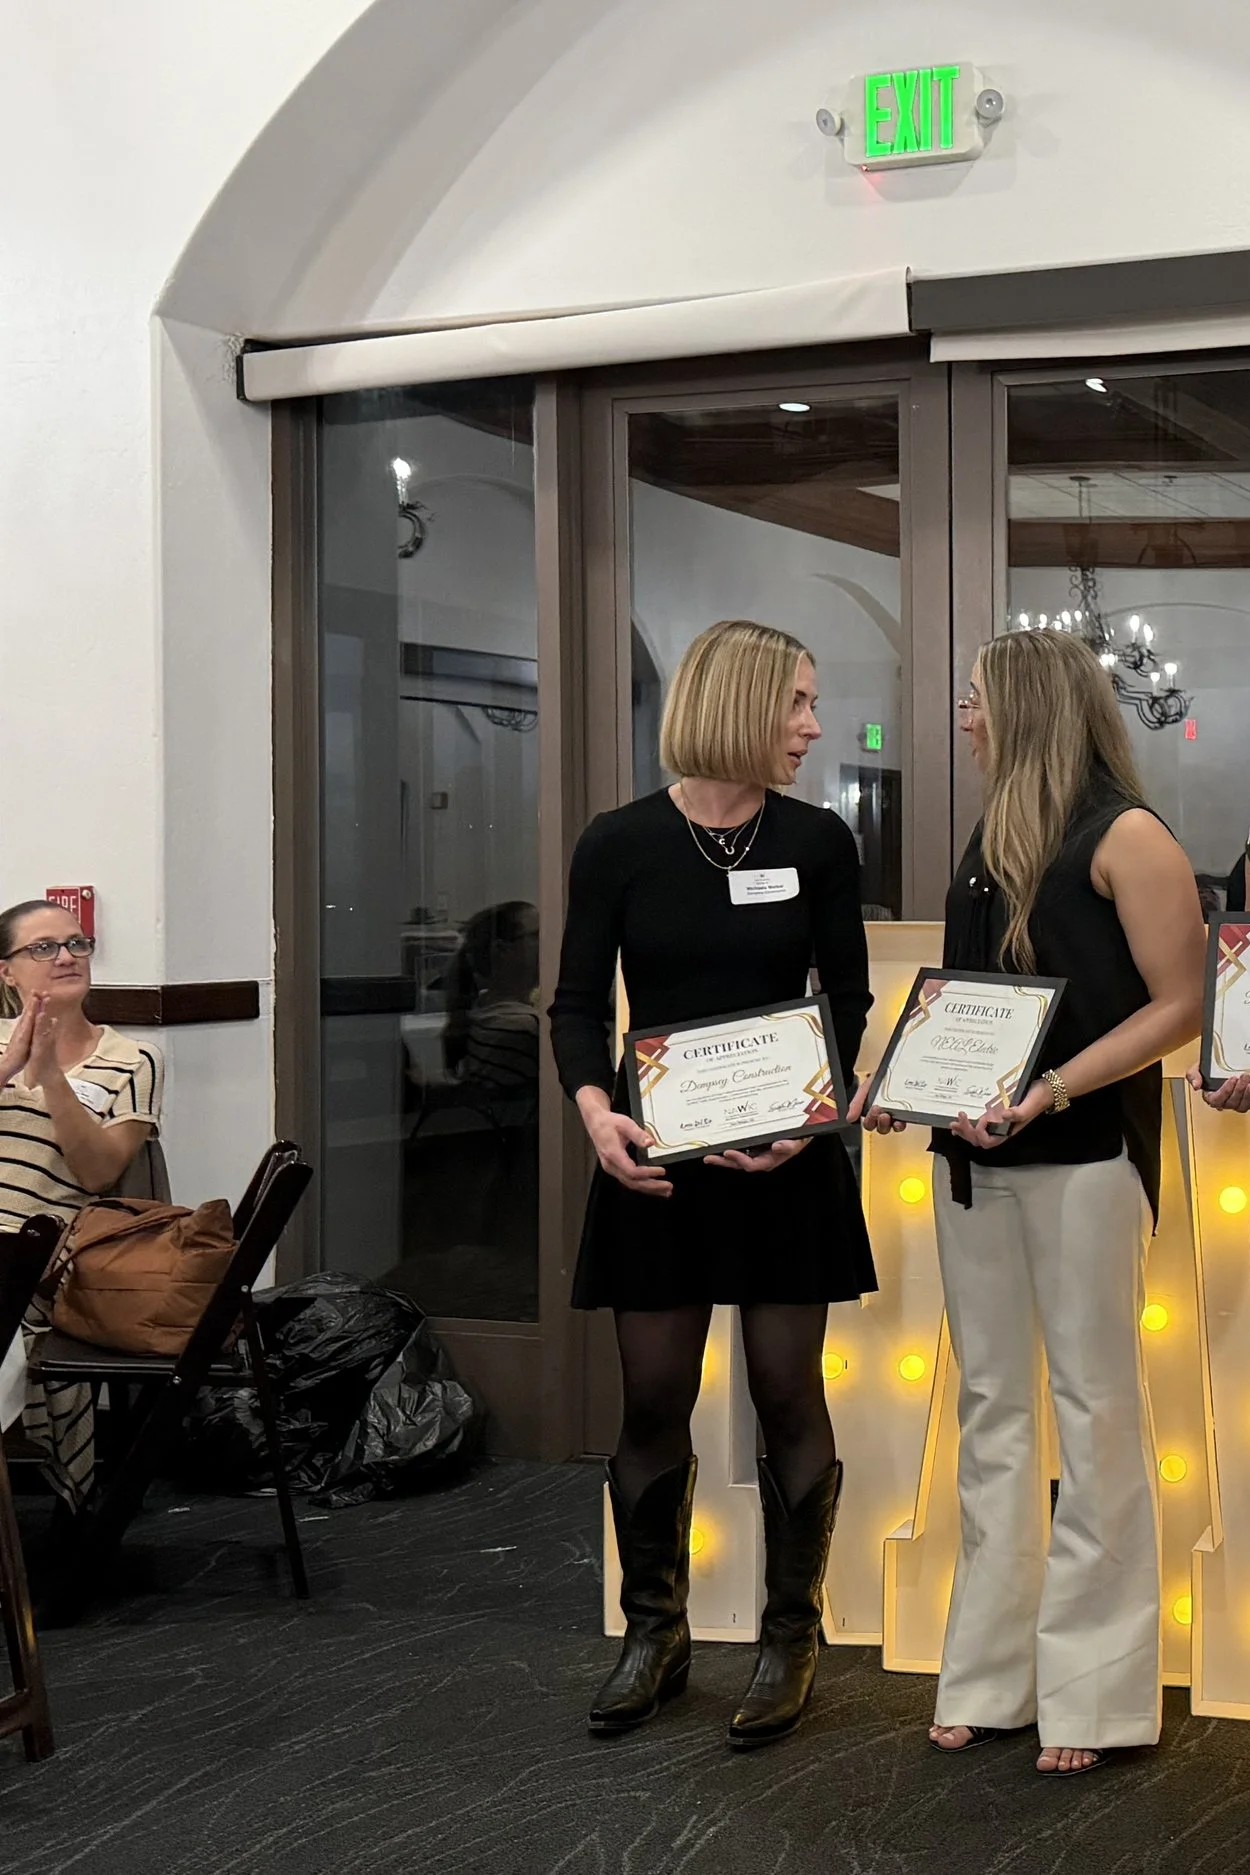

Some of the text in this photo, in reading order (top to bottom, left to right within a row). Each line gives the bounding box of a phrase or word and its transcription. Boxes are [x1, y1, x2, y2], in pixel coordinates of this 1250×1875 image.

[865, 65, 960, 158] EXIT
[944, 1002, 1014, 1020] CERTIFICATE
[683, 1032, 779, 1060] CERTIFICATE
[679, 1078, 729, 1094] Dempsey
[732, 1064, 792, 1084] Construction
